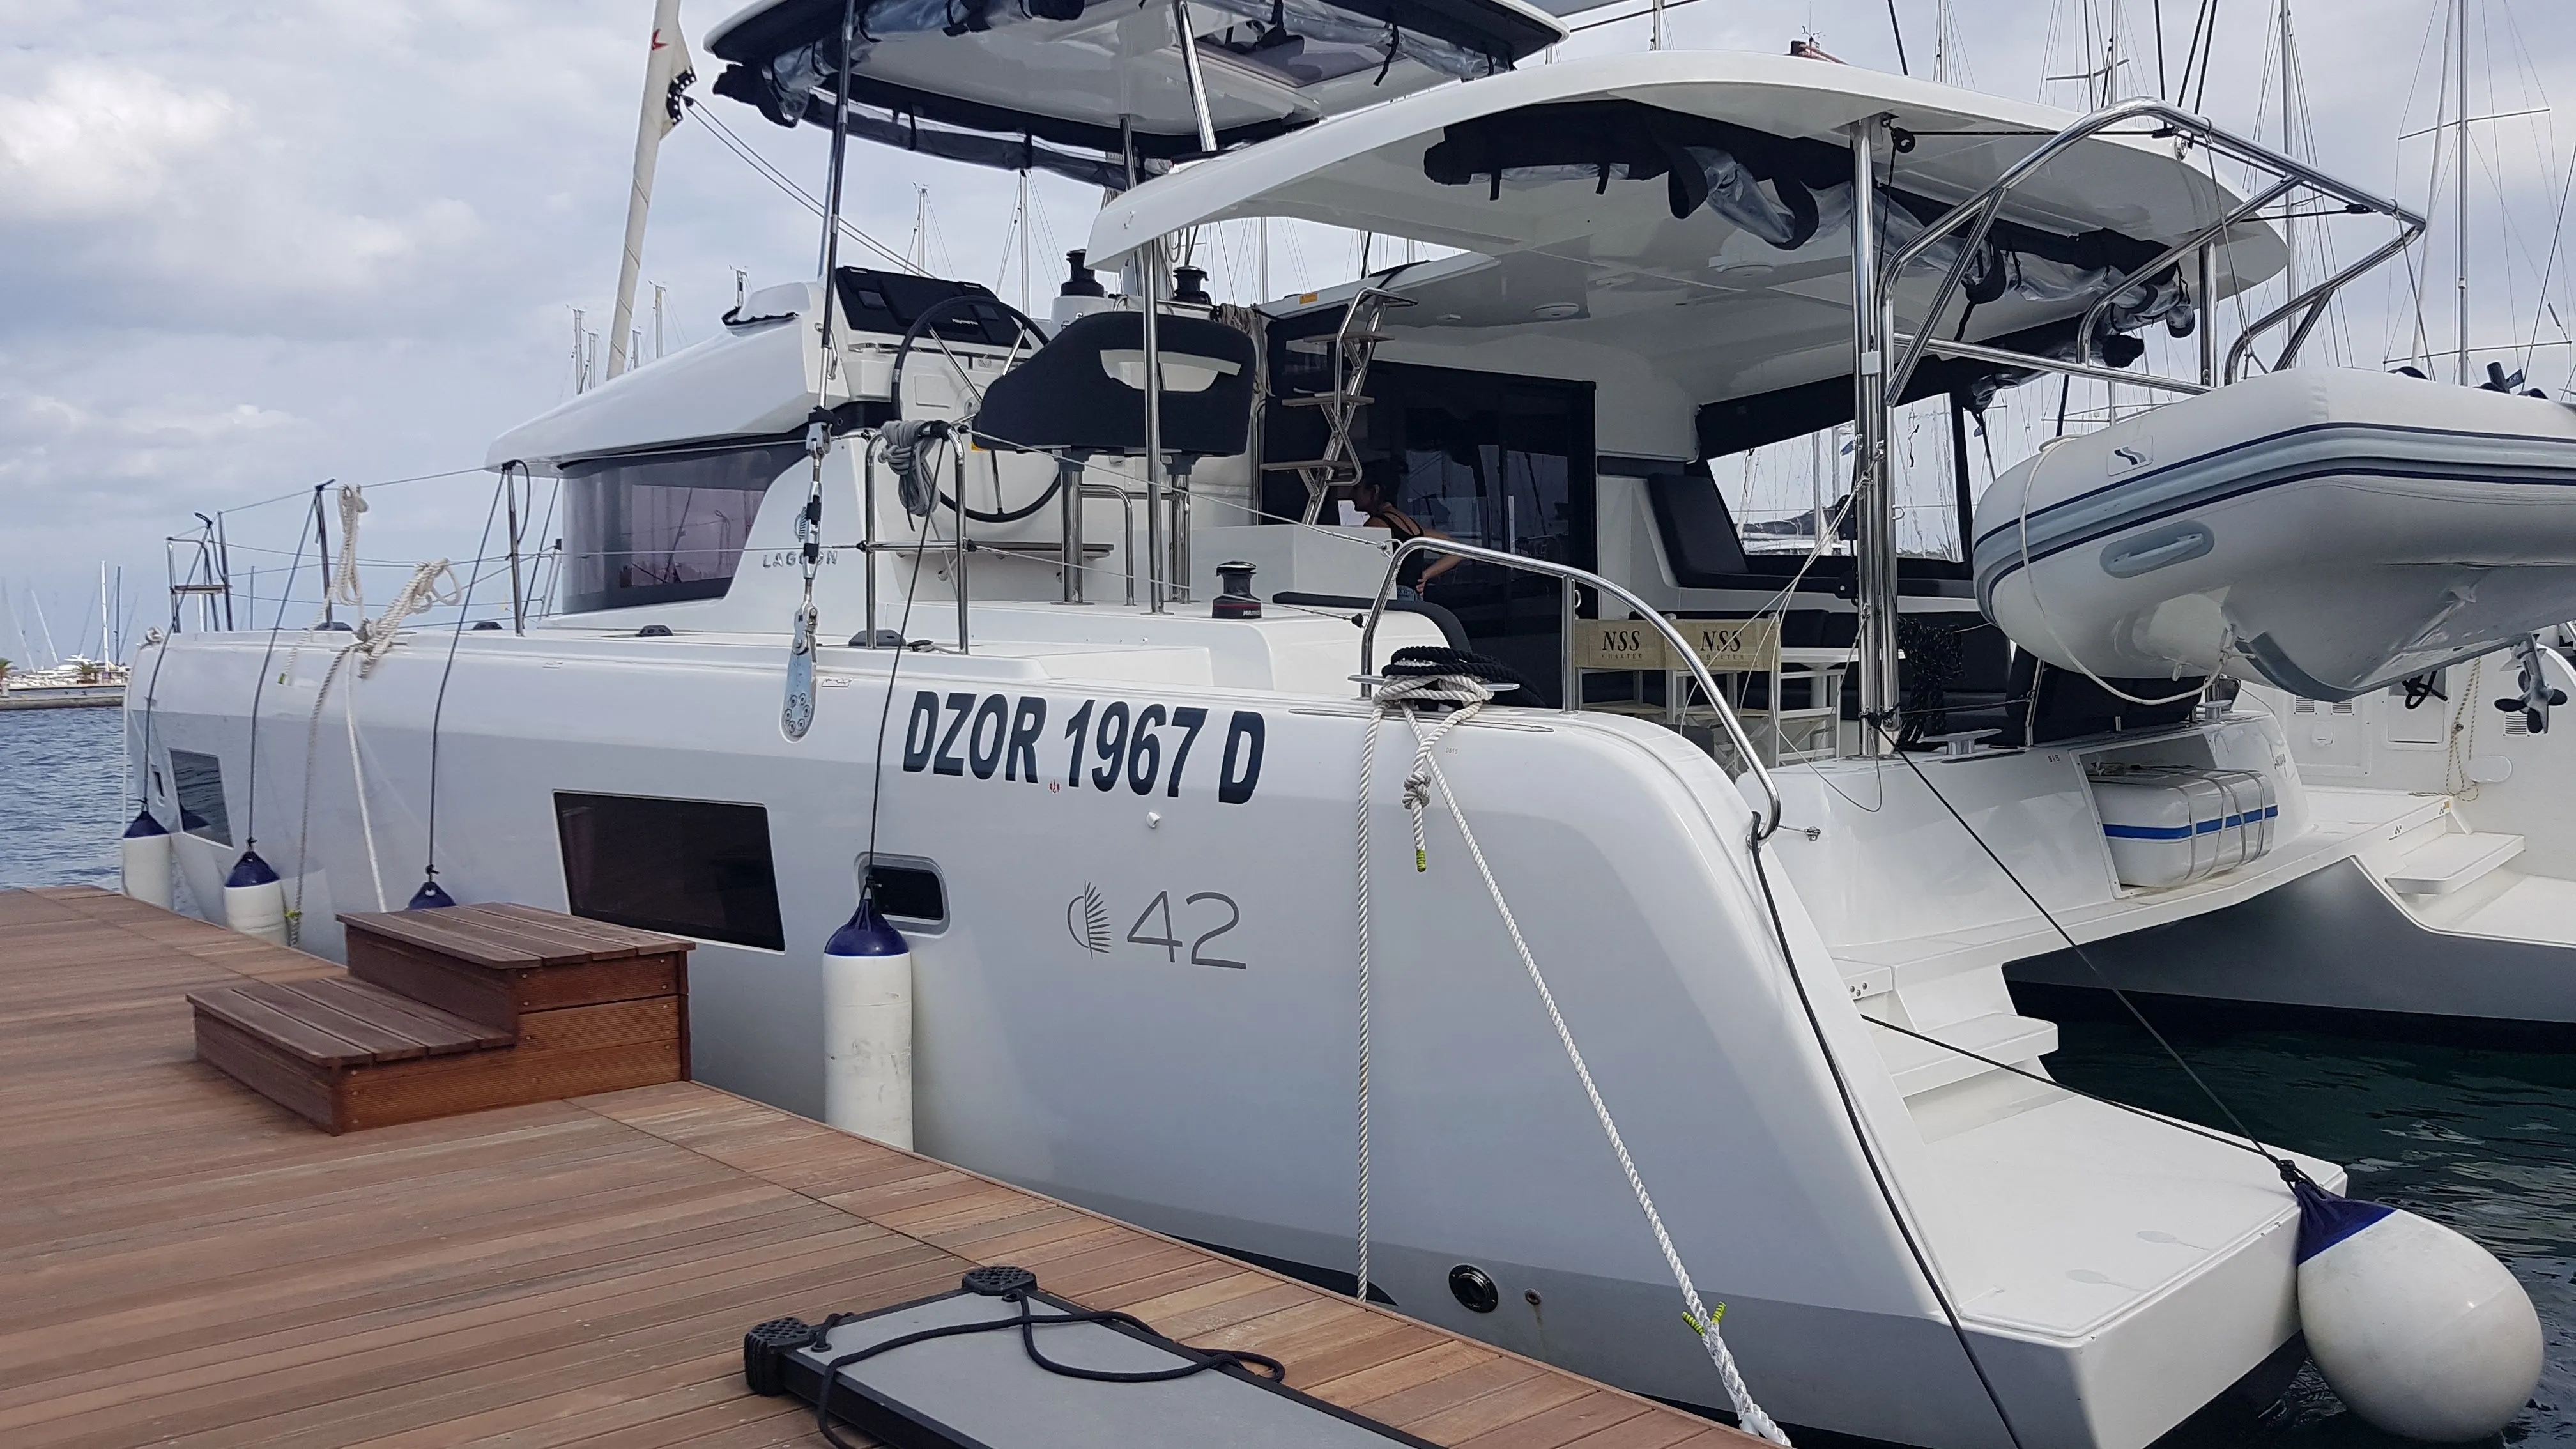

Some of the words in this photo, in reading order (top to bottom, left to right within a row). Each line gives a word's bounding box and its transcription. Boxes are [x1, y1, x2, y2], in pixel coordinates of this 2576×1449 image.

[1602, 630, 1640, 652] NSS
[1700, 630, 1742, 652] NSS
[903, 691, 1046, 783] DZOR
[1064, 700, 1208, 797] 1967
[1218, 710, 1266, 804] D
[1127, 891, 1246, 969] 42
